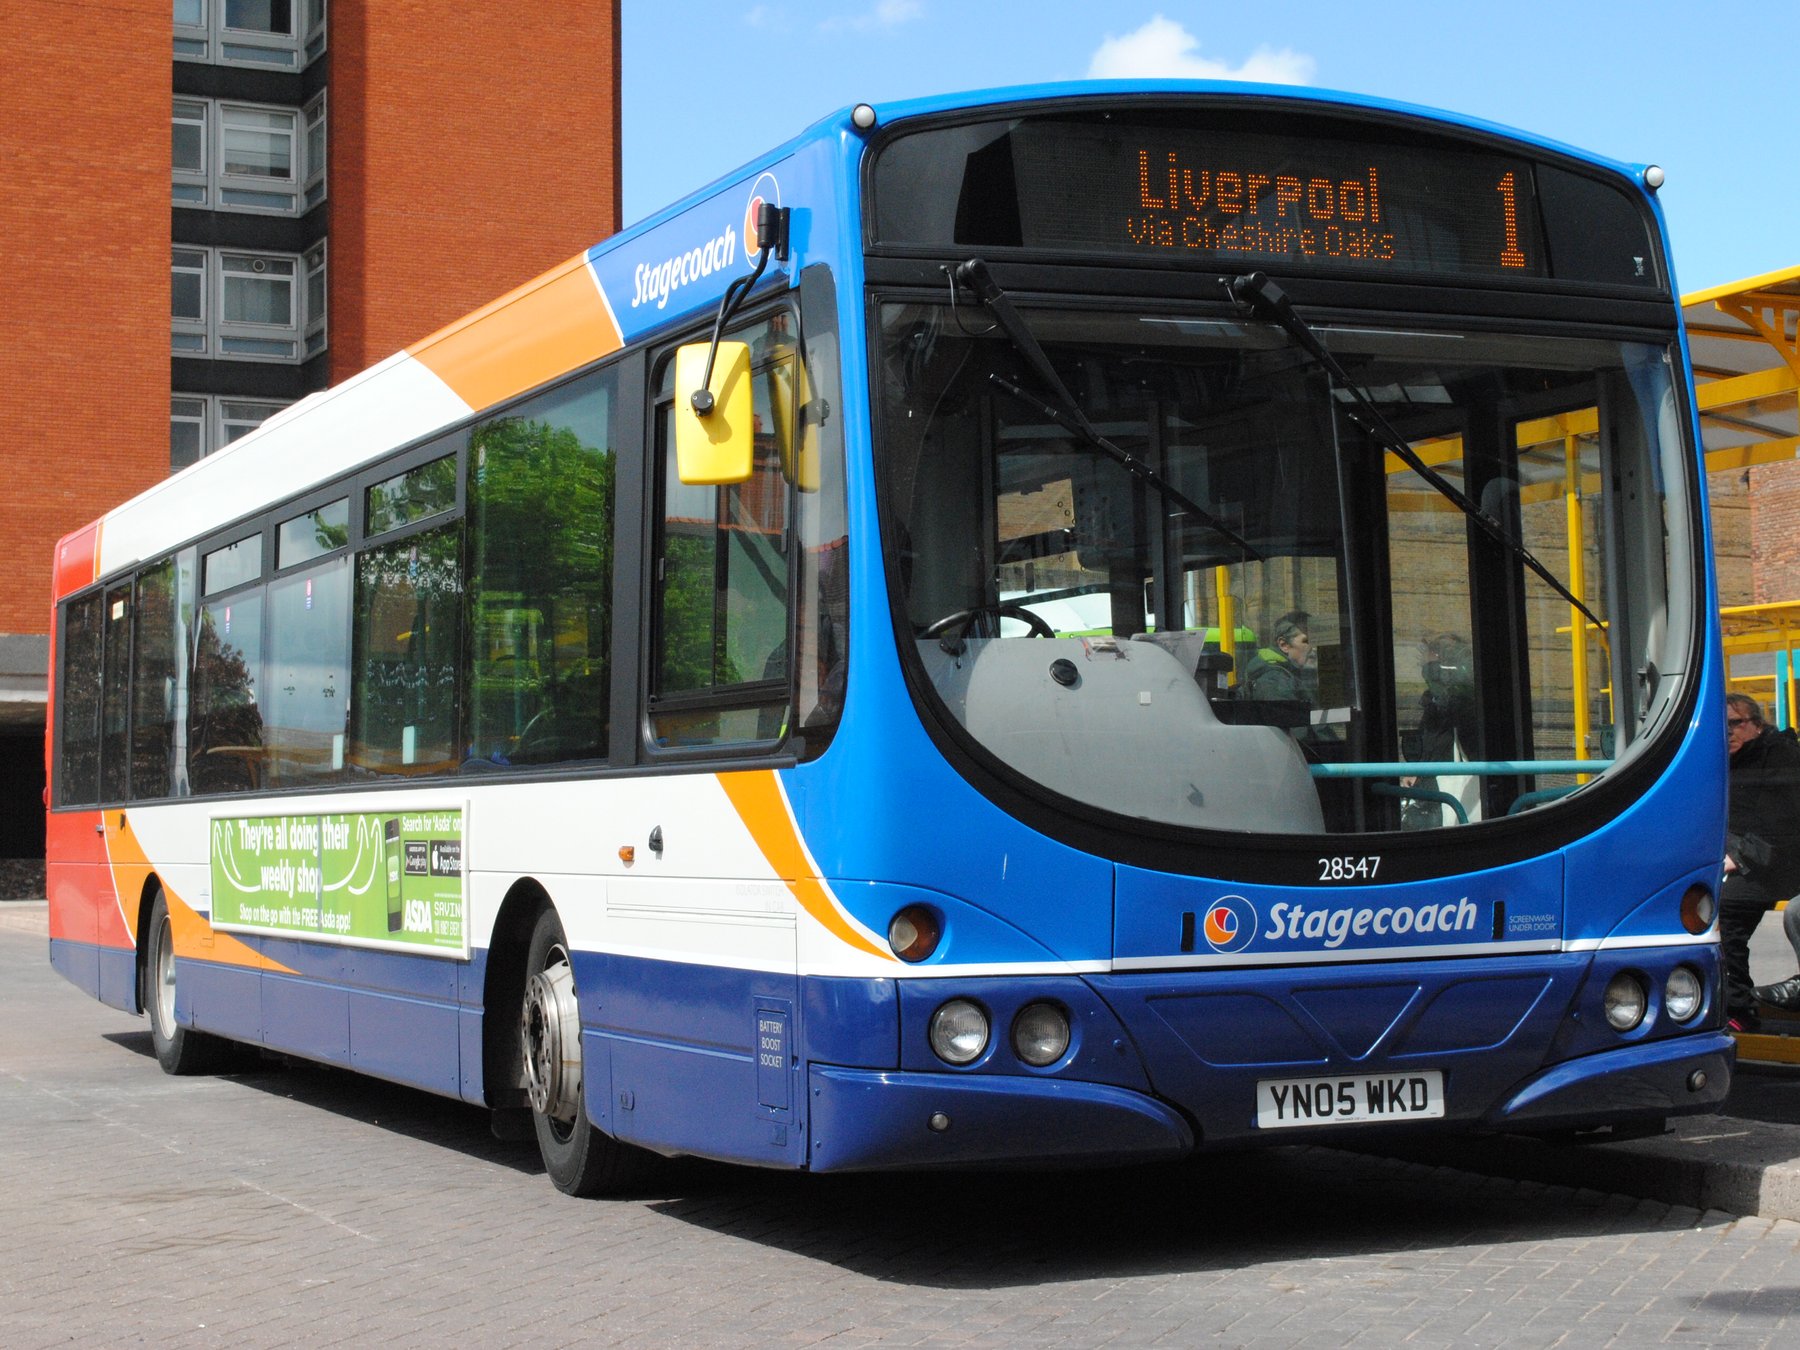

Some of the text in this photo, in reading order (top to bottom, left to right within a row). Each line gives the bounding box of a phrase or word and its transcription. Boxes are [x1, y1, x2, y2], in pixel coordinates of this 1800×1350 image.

[1139, 150, 1379, 223] Liverpool
[1496, 172, 1525, 267] 1
[1127, 214, 1395, 259] via Cheshire Oaks
[631, 223, 736, 310] Stagecoach
[239, 814, 350, 857] They're all doing their
[402, 815, 423, 832] Search
[423, 814, 432, 832] for
[260, 858, 322, 901] weekly shop
[439, 855, 450, 874] App
[1318, 856, 1381, 881] 28547
[240, 902, 351, 934] Shop on the go with the FREE Asda app!
[403, 899, 433, 934] ASDA
[434, 900, 462, 918] SAVIN
[1264, 896, 1478, 949] Stagecoach
[1509, 914, 1555, 924] SCREENWASH
[1508, 922, 1557, 932] UNDER DOOR
[759, 1019, 783, 1034] BATTERY
[761, 1036, 781, 1051] BOOST
[760, 1053, 783, 1068] SOCKET
[1270, 1077, 1429, 1120] YN05 WKD
